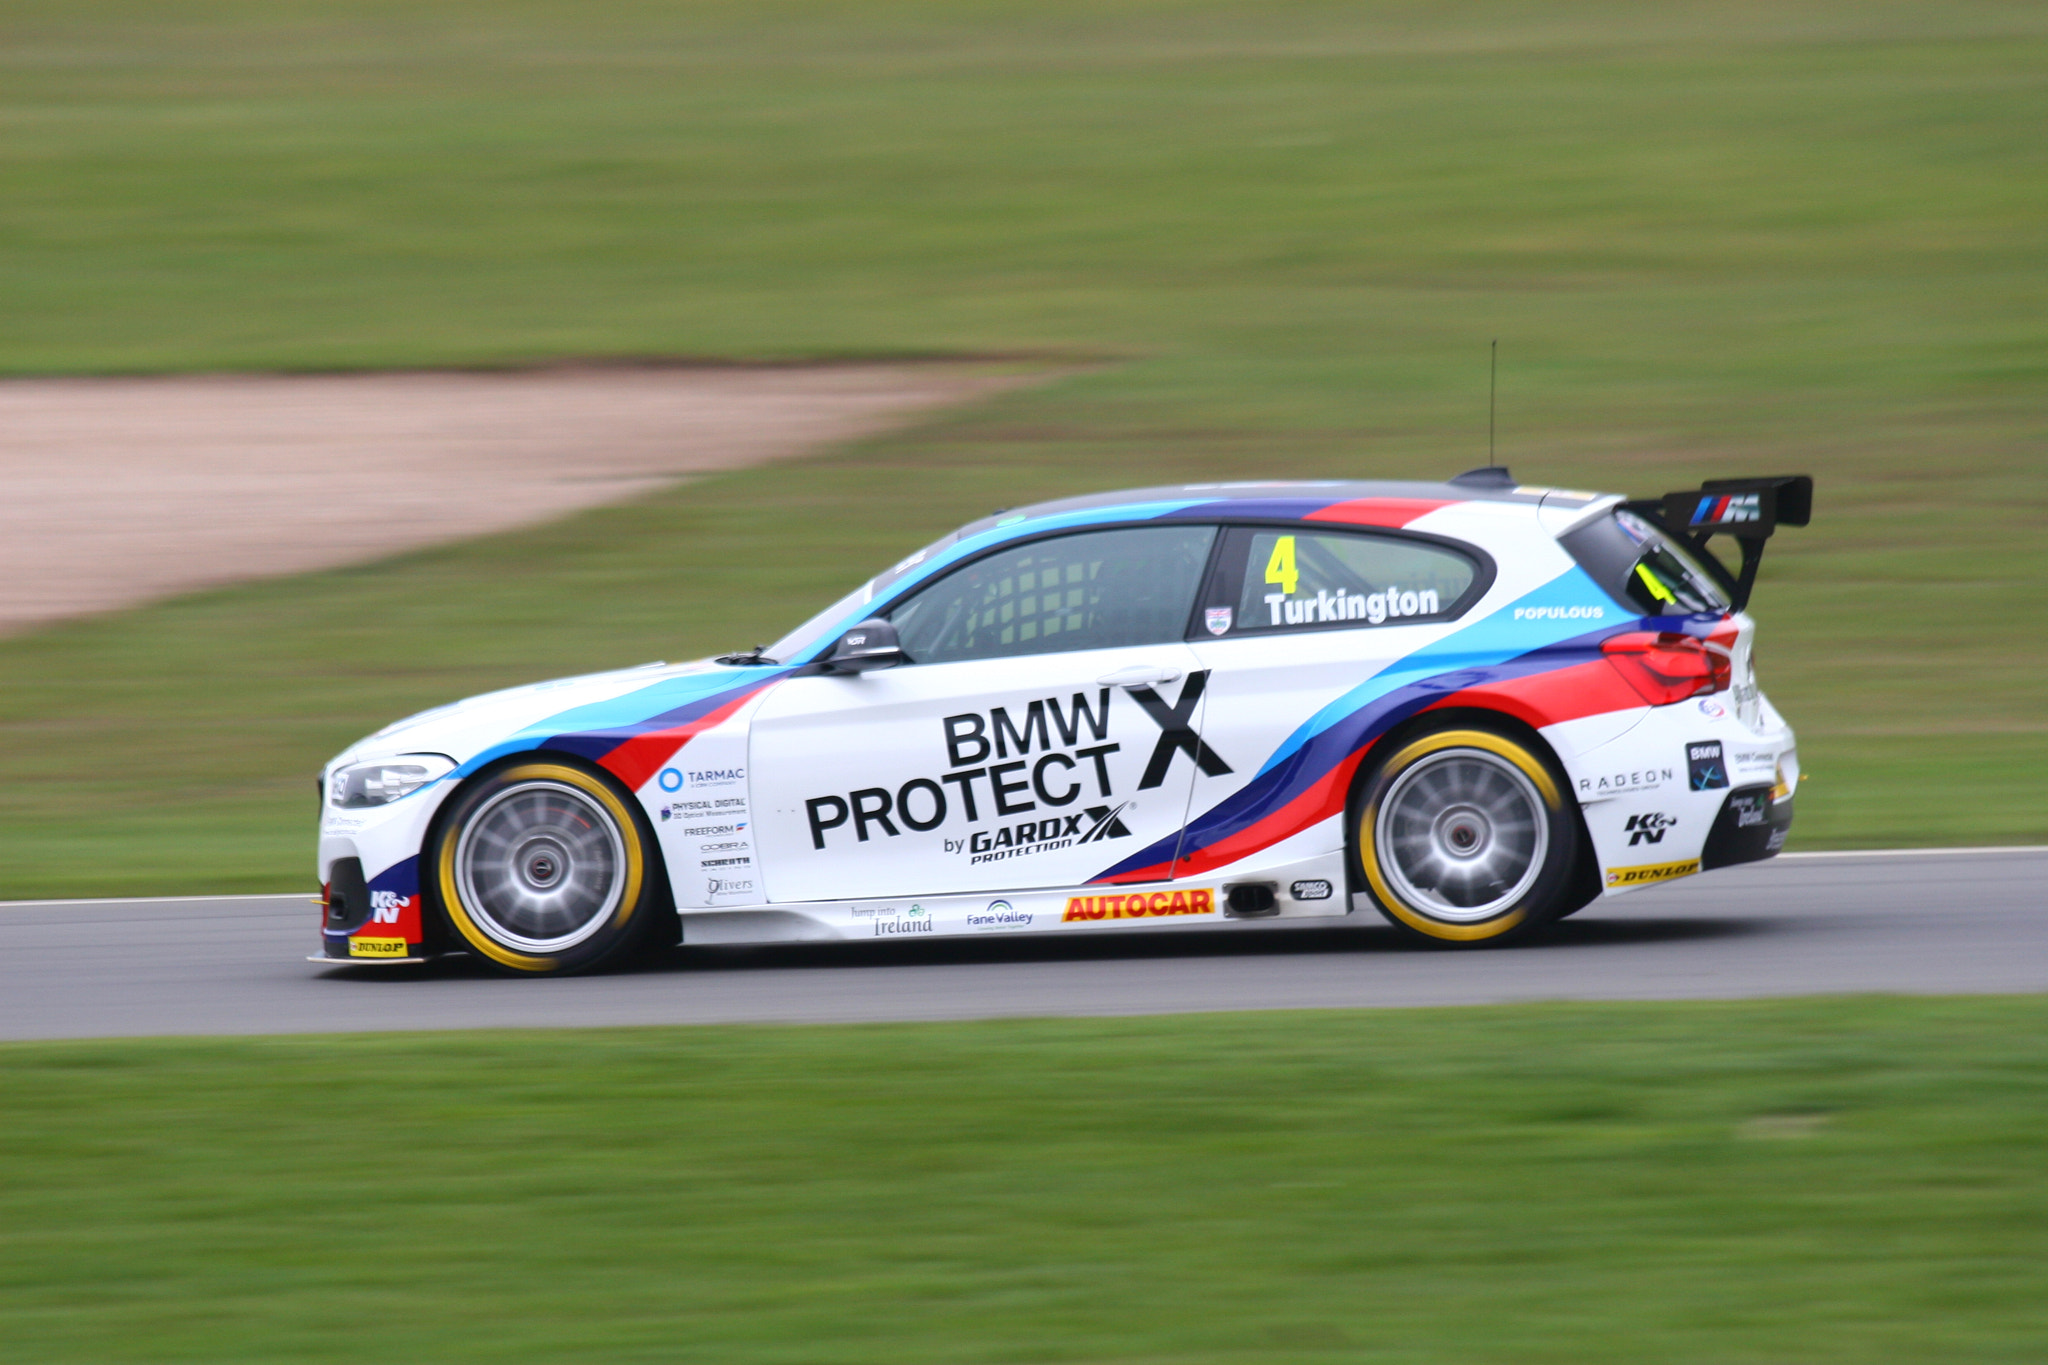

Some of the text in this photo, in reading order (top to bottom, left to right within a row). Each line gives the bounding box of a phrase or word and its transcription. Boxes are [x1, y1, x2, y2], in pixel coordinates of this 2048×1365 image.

[1265, 535, 1299, 594] 4
[1264, 587, 1439, 625] Turkington
[1514, 606, 1604, 620] POPULOUS
[943, 687, 1111, 768] BMW
[1123, 669, 1235, 790] X
[1690, 746, 1721, 760] BMW
[688, 768, 745, 782] TARMAC
[1579, 768, 1672, 791] RADEON
[672, 798, 746, 811] PHYSICAL DIGITAL
[805, 743, 1121, 850] PROTECT
[684, 825, 734, 837] FREEFORM
[700, 842, 749, 851] COBRA
[944, 838, 964, 854] by
[970, 839, 1072, 865] PROTECTION
[1623, 863, 1699, 882] DUNLOP
[851, 906, 896, 920] Jump into
[1065, 890, 1212, 921] AUTOCAR
[874, 914, 933, 936] Ireland
[967, 911, 1033, 925] Fane Valley
[358, 943, 404, 952] DUNLOP
